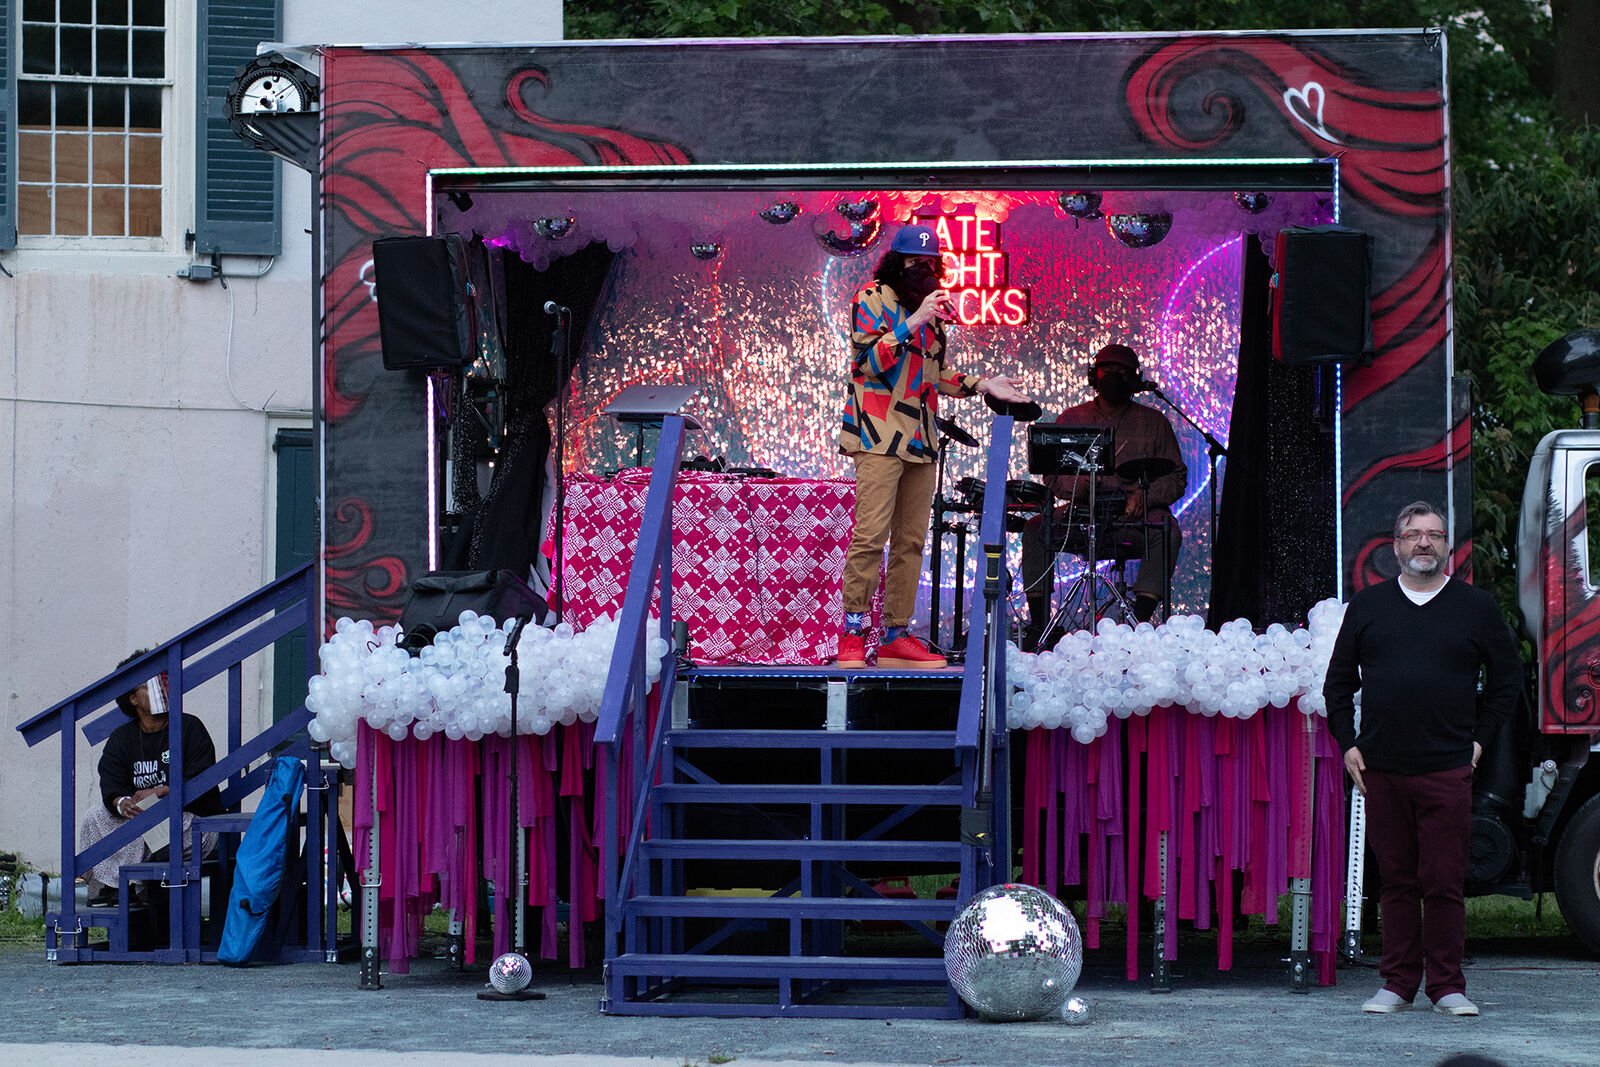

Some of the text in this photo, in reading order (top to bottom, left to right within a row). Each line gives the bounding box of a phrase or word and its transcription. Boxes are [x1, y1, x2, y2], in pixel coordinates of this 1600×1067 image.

[919, 232, 930, 247] P
[939, 251, 1002, 288] GHT
[133, 760, 159, 776] SONIA
